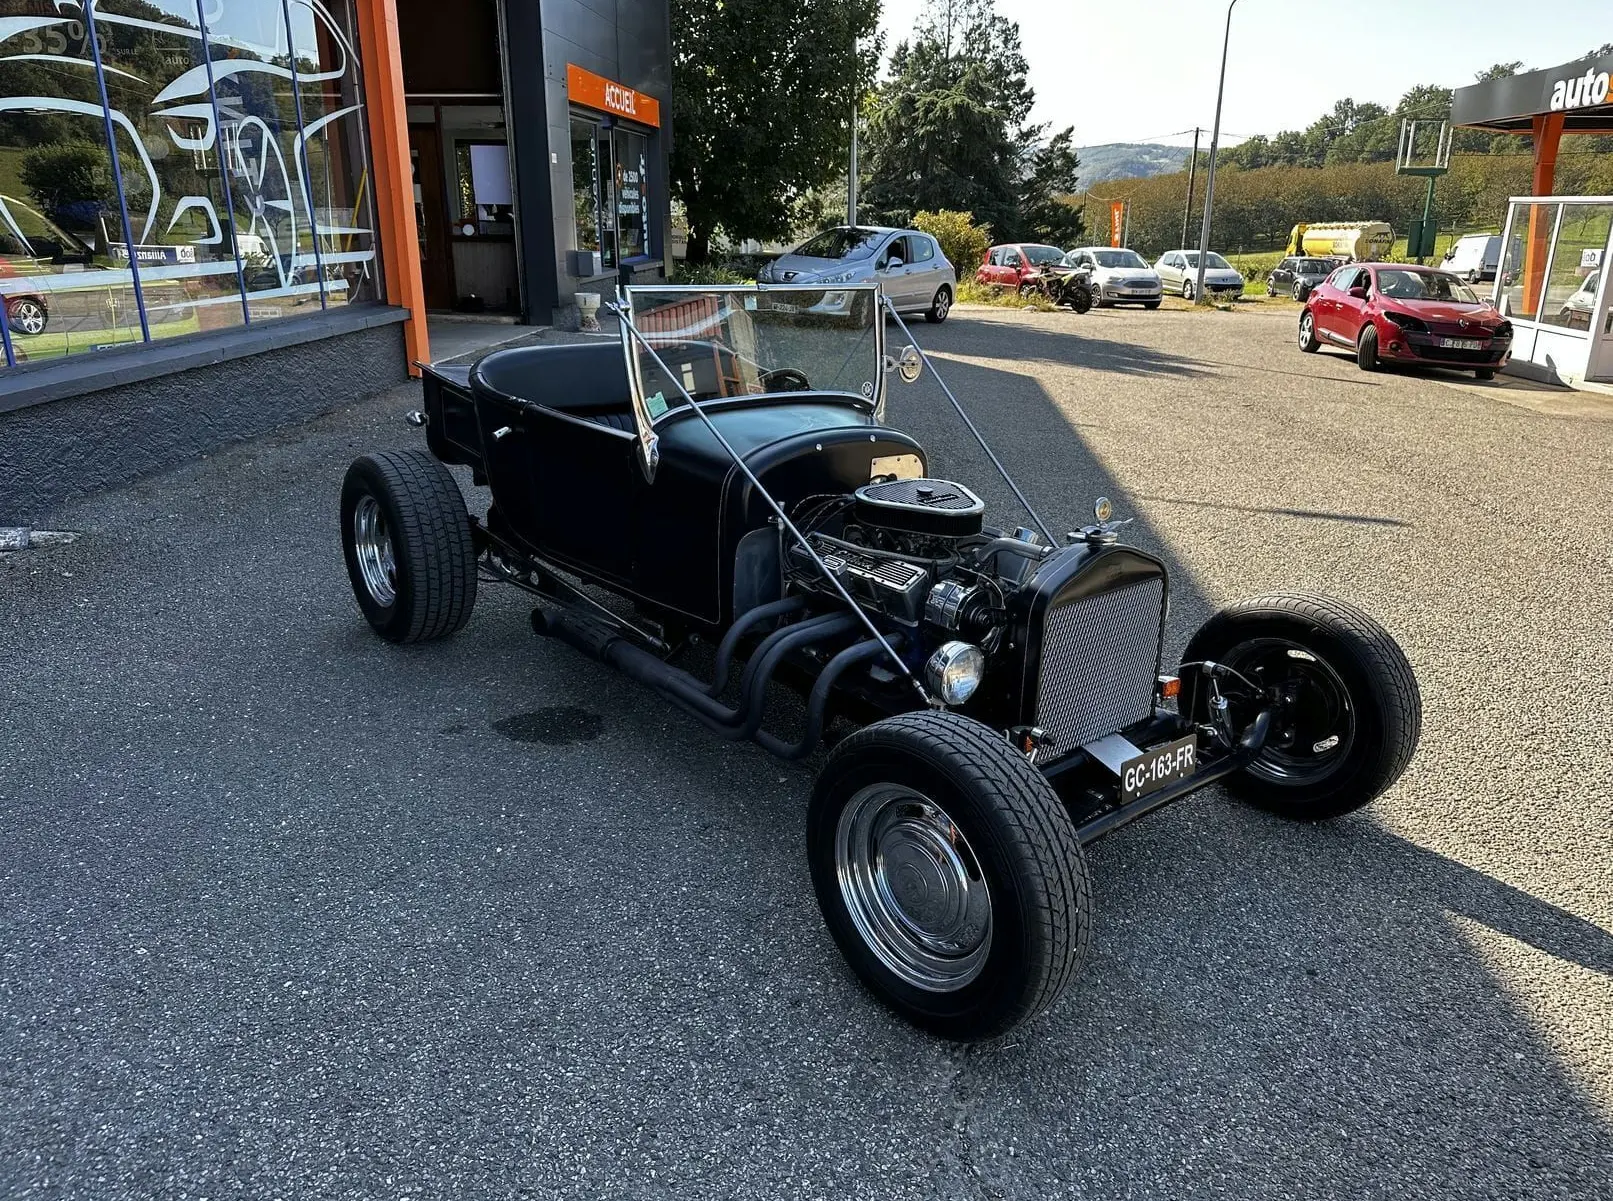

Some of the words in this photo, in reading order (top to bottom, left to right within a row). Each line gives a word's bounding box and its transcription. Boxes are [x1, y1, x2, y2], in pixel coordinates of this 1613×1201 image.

[605, 82, 636, 115] ACCUEIL
[1550, 67, 1613, 111] auto
[1124, 743, 1194, 792] GC-163-FR
